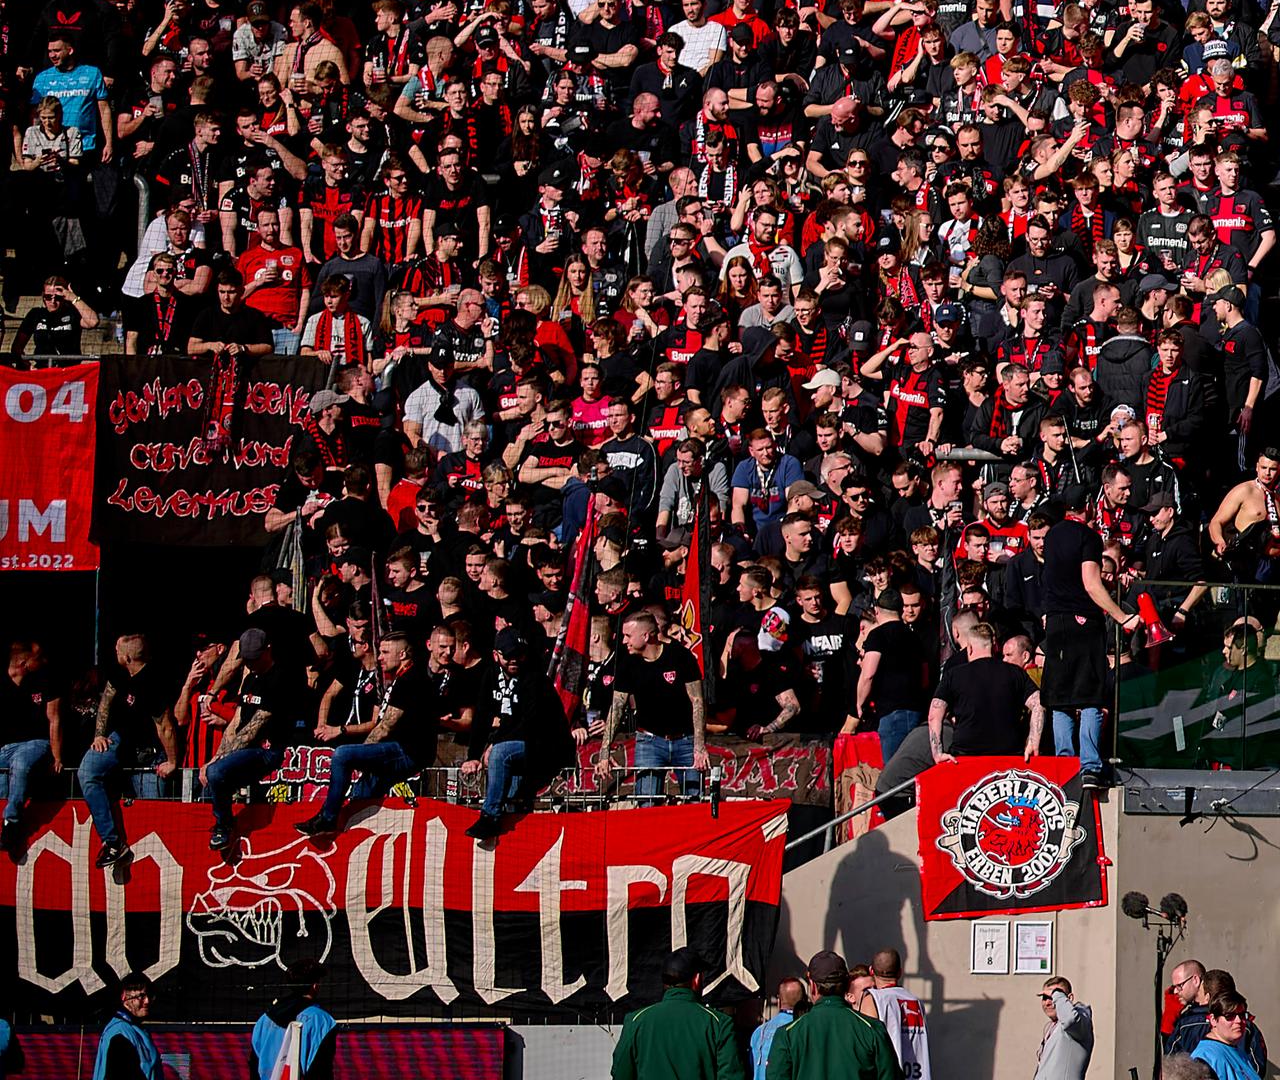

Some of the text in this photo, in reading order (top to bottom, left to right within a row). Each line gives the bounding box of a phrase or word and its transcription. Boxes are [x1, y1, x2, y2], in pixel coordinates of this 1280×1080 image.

[1212, 216, 1246, 228] armenia
[1147, 235, 1188, 249] Barmenia
[4, 380, 90, 423] 04
[961, 779, 1065, 835] HABERLANDS
[965, 842, 1061, 885] ERBEN 2003
[984, 940, 996, 950] FT
[987, 956, 994, 966] 8
